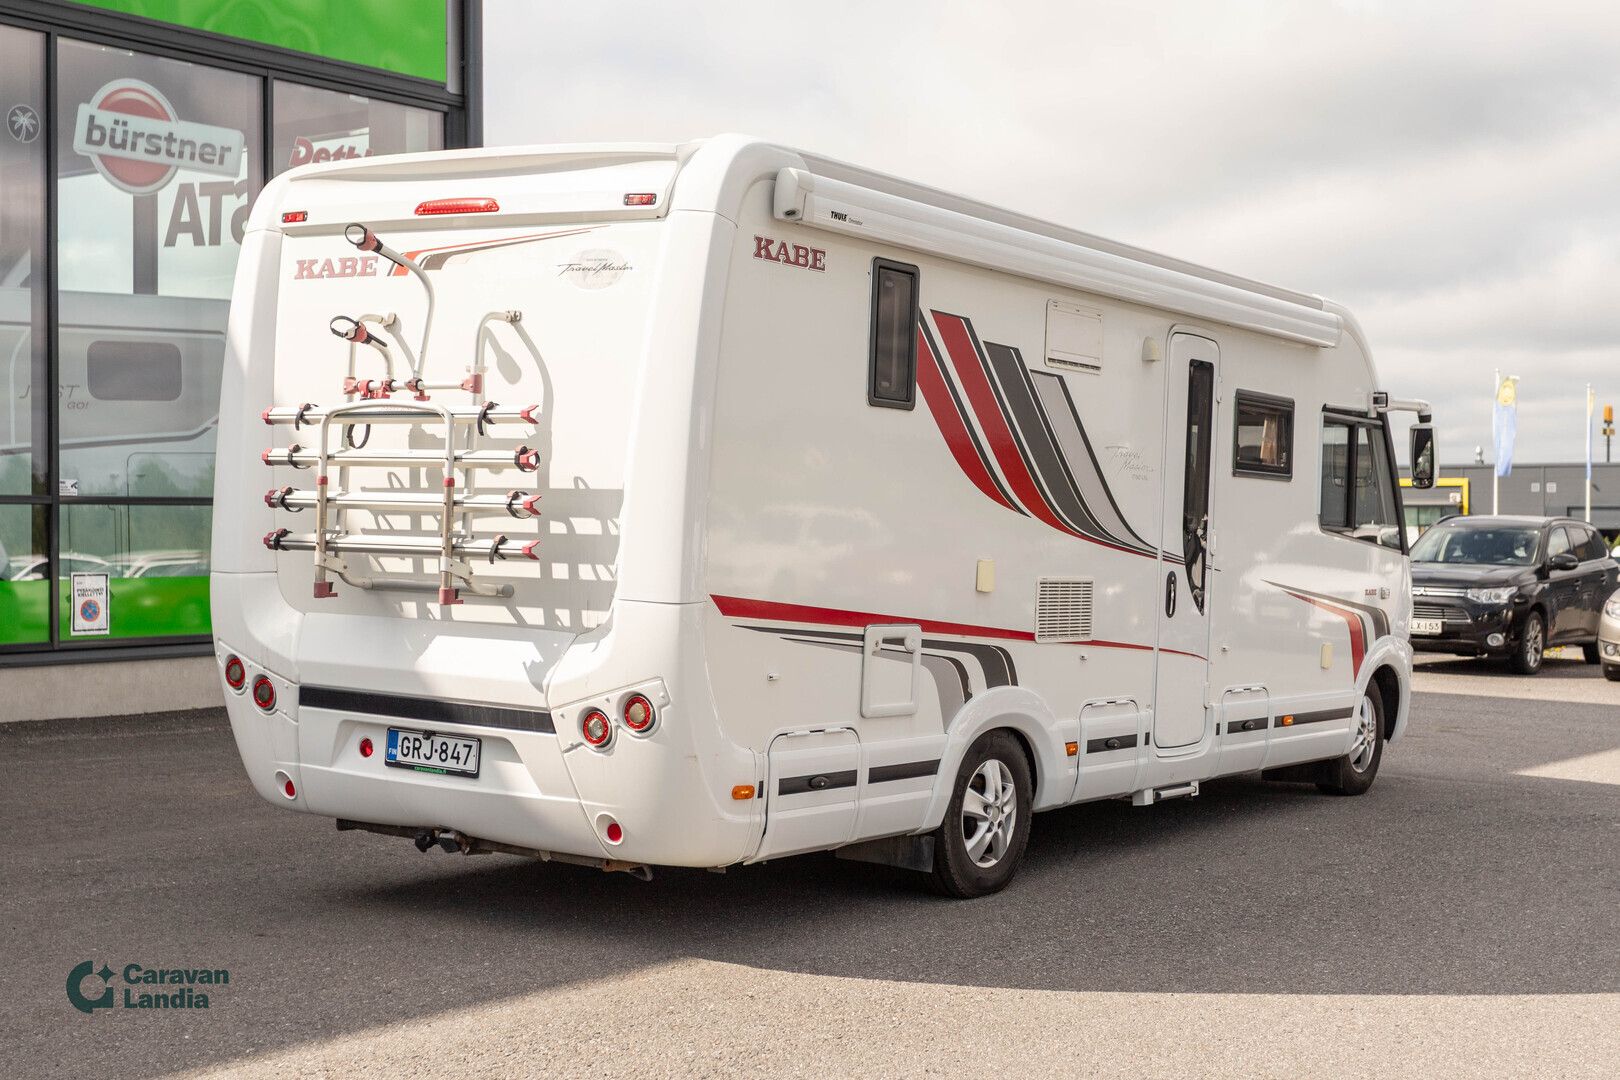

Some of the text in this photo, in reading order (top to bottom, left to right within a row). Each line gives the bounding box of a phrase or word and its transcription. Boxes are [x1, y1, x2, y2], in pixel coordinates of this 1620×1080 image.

[86, 115, 232, 167] bürstner
[294, 256, 378, 279] KABE
[753, 235, 826, 271] KABE
[401, 736, 474, 765] GRJ-847
